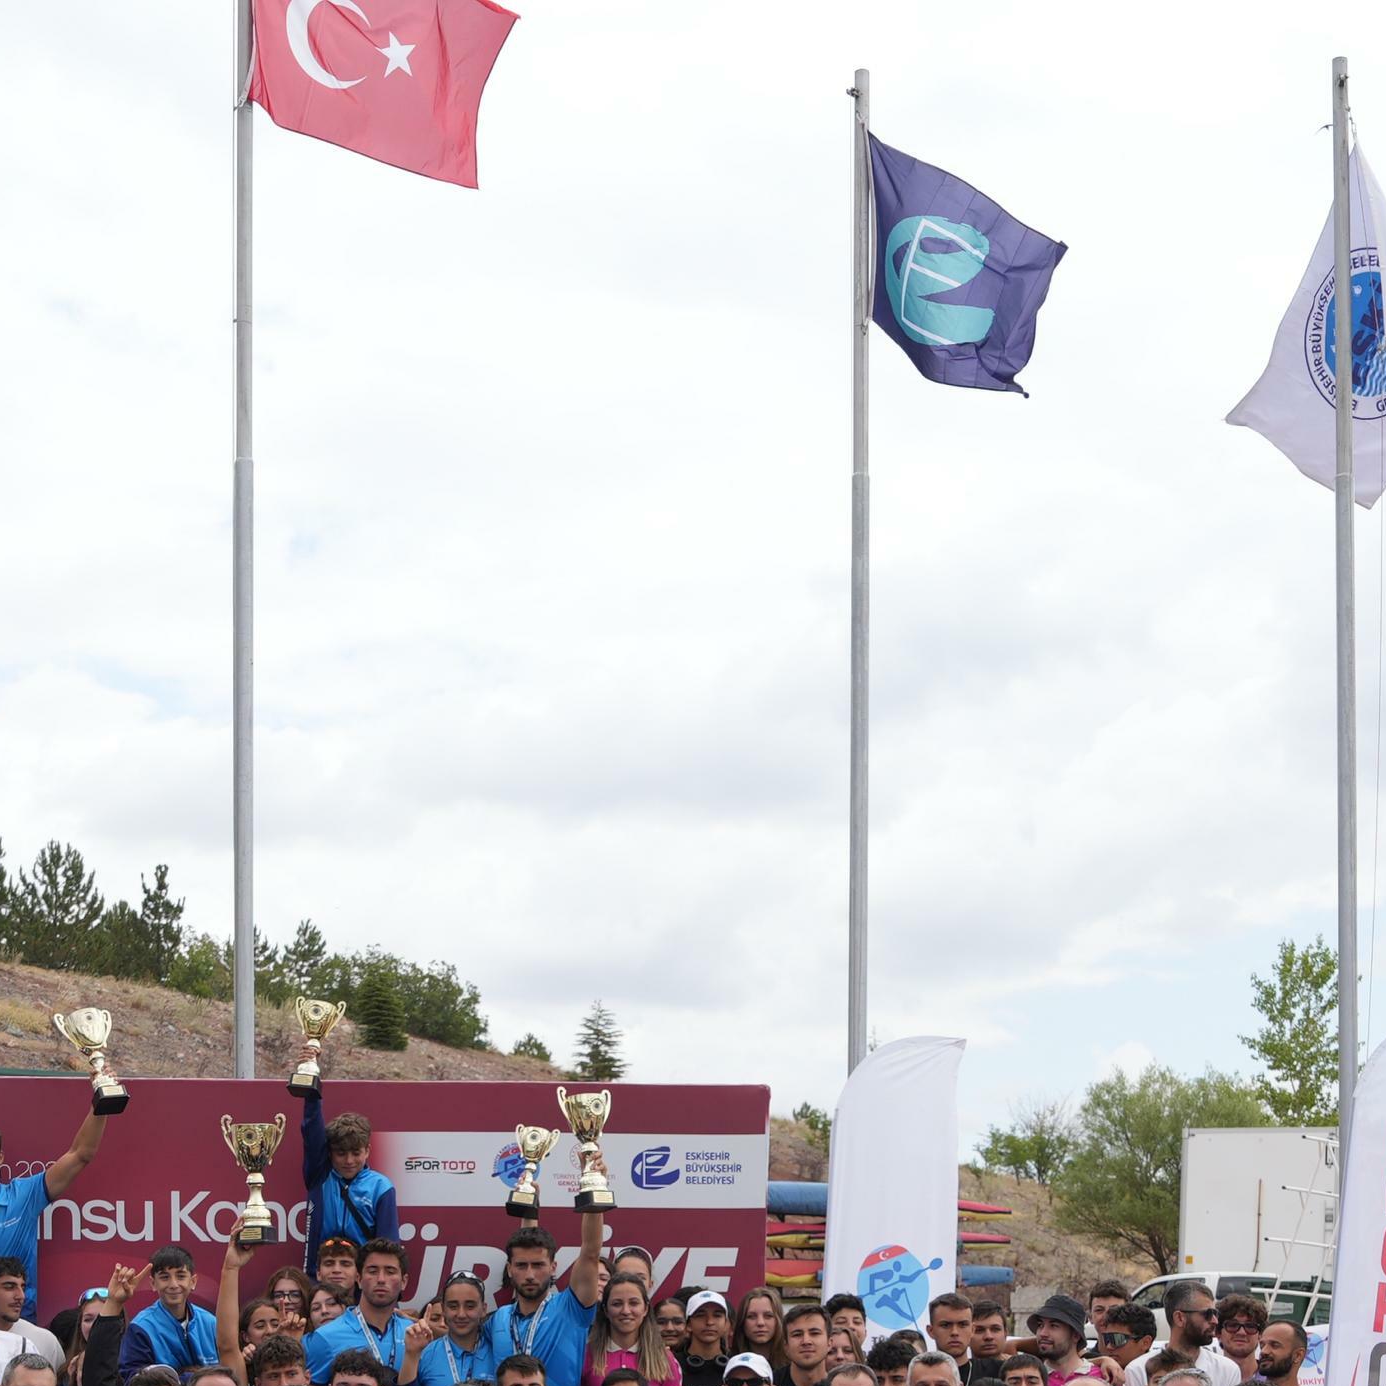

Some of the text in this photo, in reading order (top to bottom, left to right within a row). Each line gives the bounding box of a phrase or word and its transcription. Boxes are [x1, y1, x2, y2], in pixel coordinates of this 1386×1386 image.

[685, 1150, 731, 1161] ESKİŞEHİR
[685, 1162, 742, 1173] BÜYÜKŞEHİR
[685, 1174, 735, 1185] BELEDİYESİ
